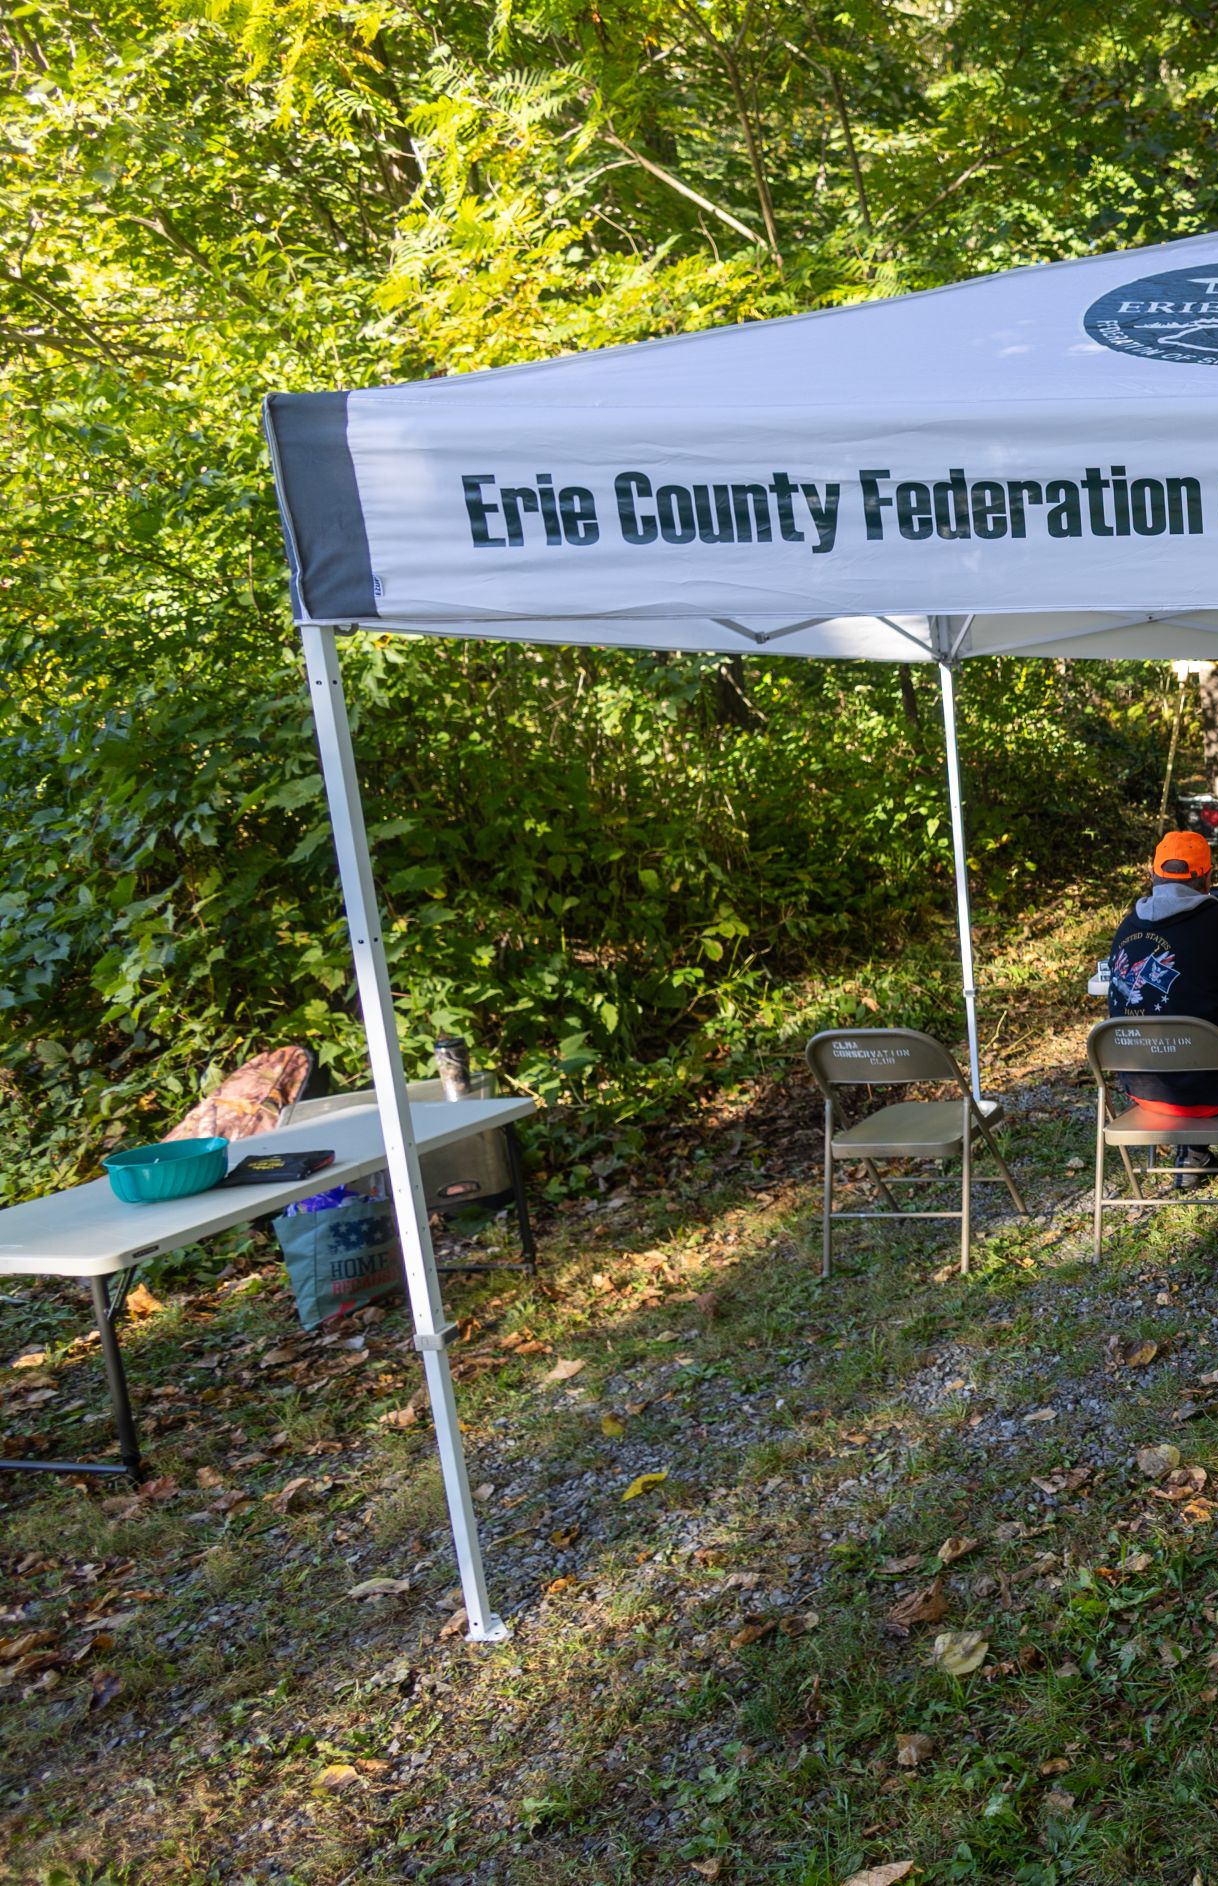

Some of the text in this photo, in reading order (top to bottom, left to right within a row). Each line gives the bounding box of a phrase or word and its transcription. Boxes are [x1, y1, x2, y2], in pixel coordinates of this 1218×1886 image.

[1161, 352, 1196, 361] OF
[461, 473, 599, 548] Erie
[614, 471, 841, 554] County
[859, 465, 1204, 541] Federation
[1119, 932, 1171, 951] UNITED STATES
[1125, 1007, 1145, 1017] NAVY
[1114, 1029, 1141, 1037] ELMA
[1114, 1037, 1192, 1046] CONSERVATION
[832, 1048, 911, 1058] CONSERVATION
[329, 1252, 389, 1280] HOME
